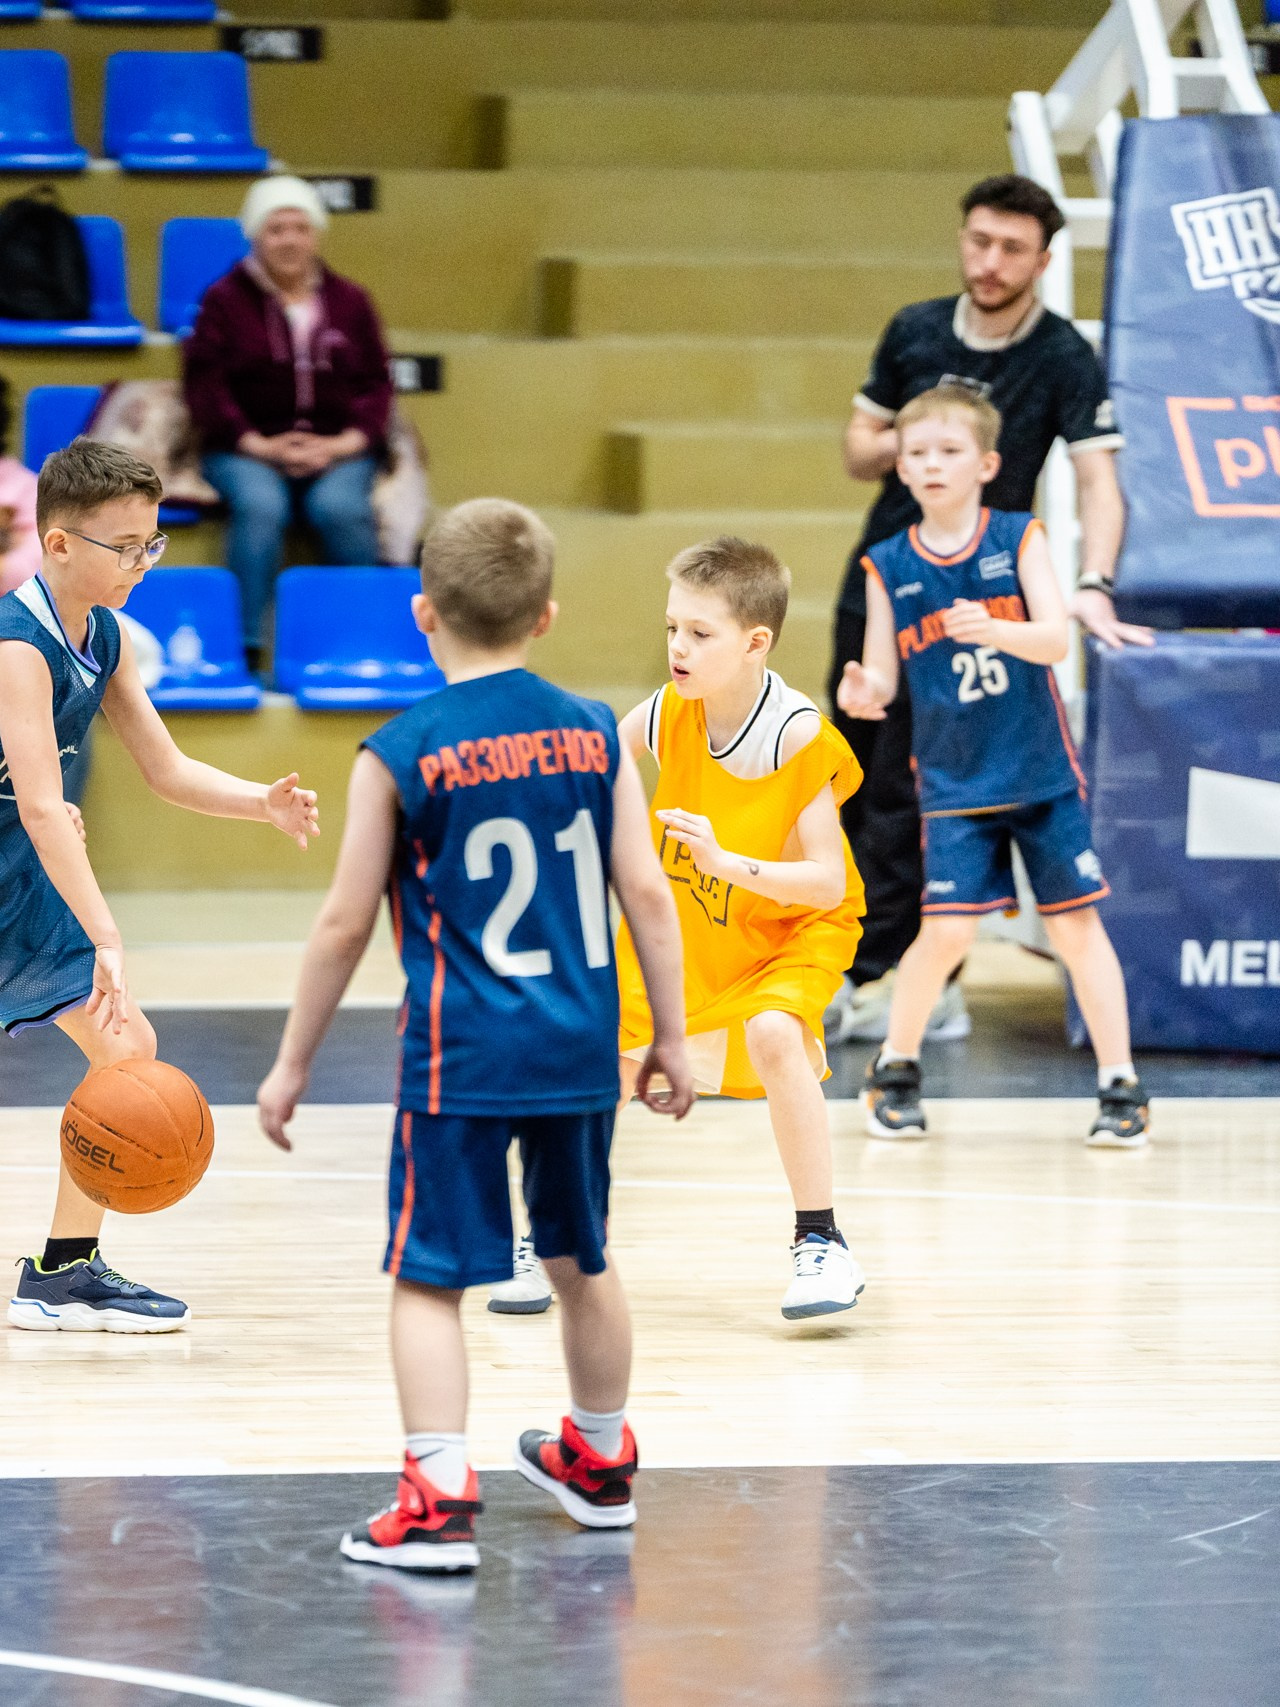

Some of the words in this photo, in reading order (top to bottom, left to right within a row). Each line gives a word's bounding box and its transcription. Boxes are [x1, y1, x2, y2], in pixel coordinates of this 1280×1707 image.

[951, 644, 1010, 704] 25
[418, 728, 609, 796] РАЗЗОРЕНОВ
[464, 808, 610, 978] 21
[60, 1119, 126, 1175] JÖGEL
